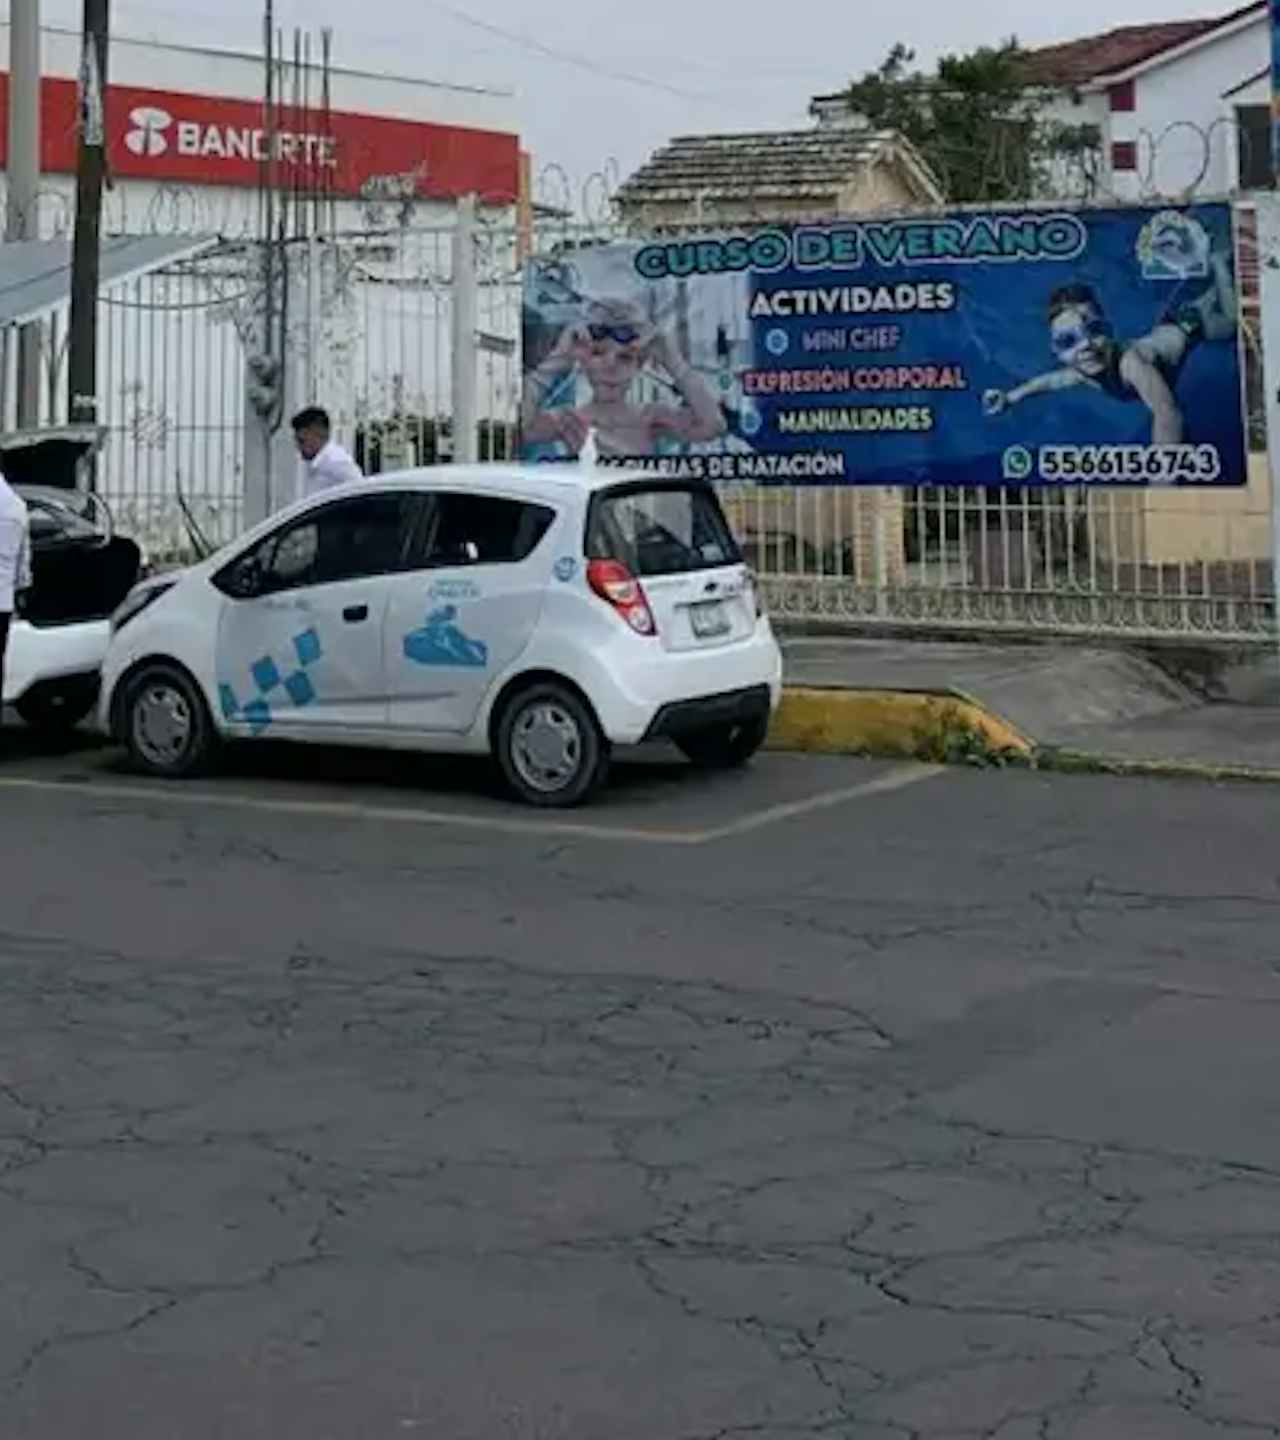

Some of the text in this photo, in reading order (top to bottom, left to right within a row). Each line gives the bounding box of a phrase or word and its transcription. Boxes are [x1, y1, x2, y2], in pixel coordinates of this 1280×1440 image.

[634, 218, 1081, 278] CURSO DE VERANO
[750, 283, 955, 317] ACTIVIDADES
[802, 326, 901, 351] MINI CHEF
[852, 366, 967, 391] CORPORAL
[778, 408, 933, 433] MANUALIDADES
[708, 456, 735, 478] DE
[738, 449, 845, 476] NATACIÓN
[1041, 446, 1217, 477] 5566156743
